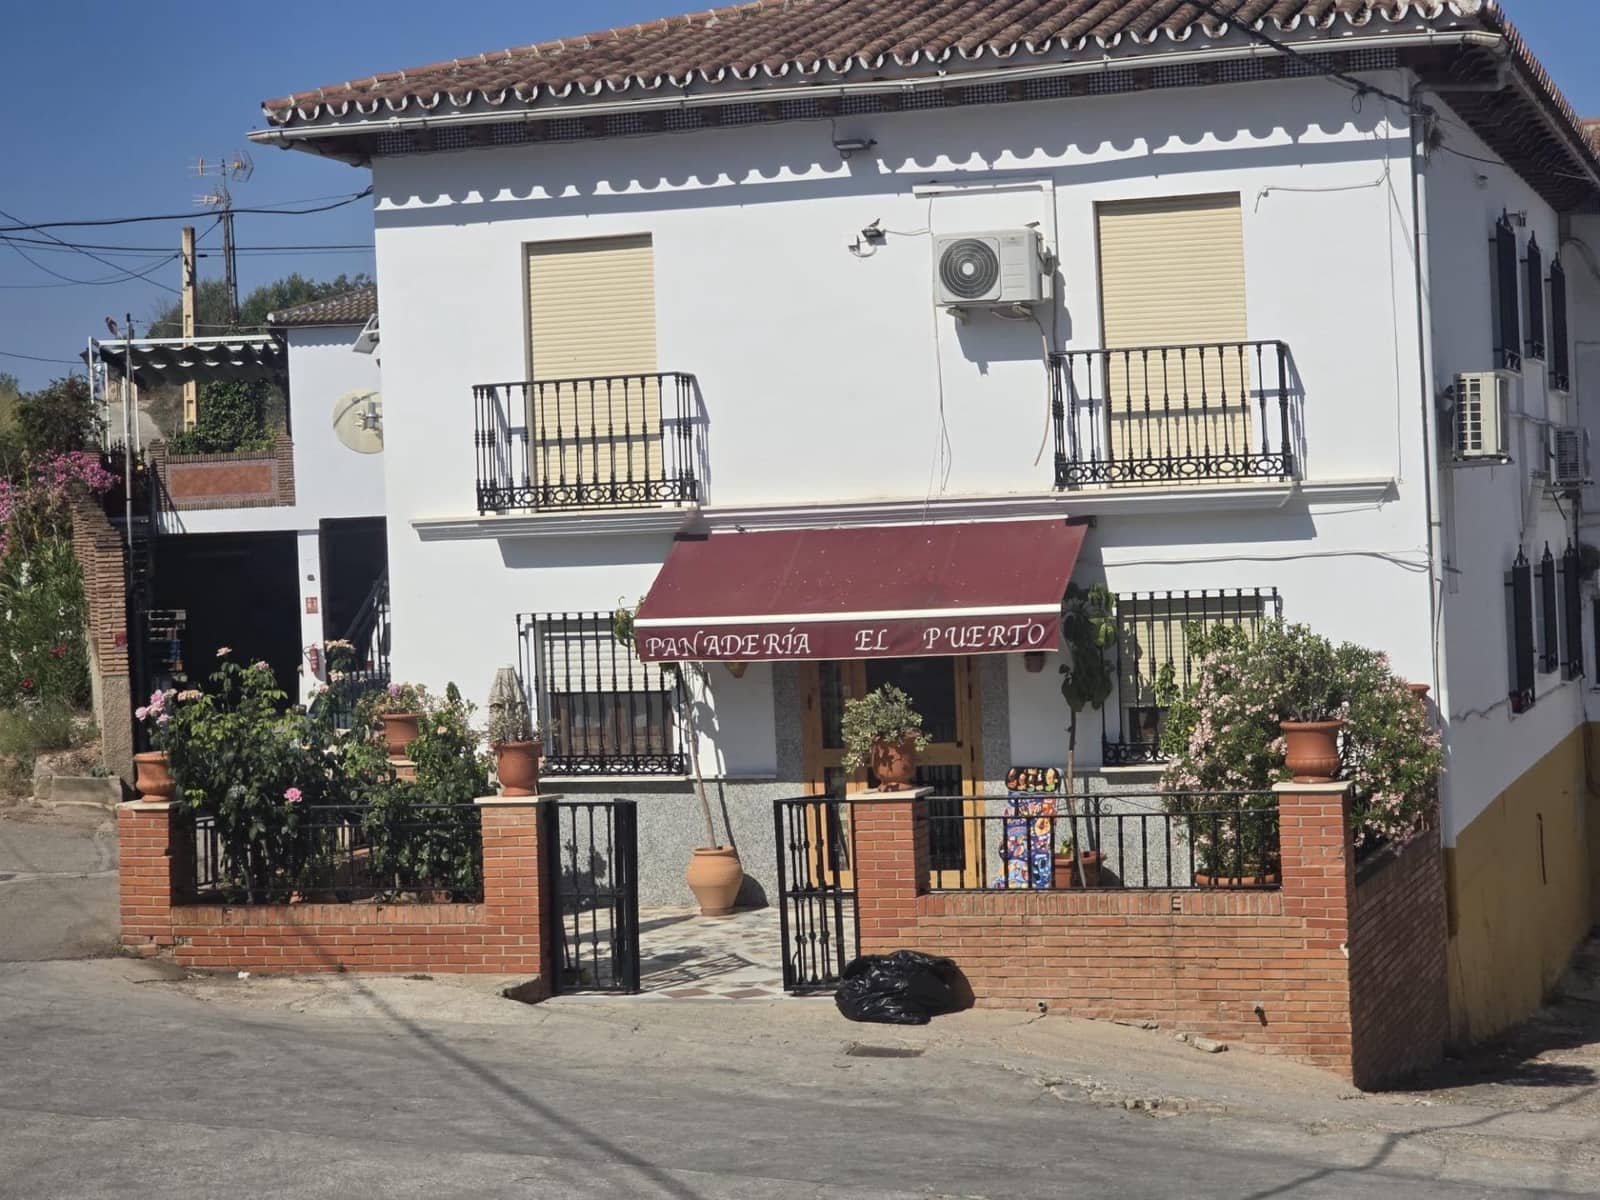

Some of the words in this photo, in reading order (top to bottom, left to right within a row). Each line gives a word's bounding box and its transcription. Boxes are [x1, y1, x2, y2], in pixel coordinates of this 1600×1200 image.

[645, 626, 812, 657] PANADERÍA
[854, 628, 889, 651] EL
[922, 617, 1046, 650] PUERTO
